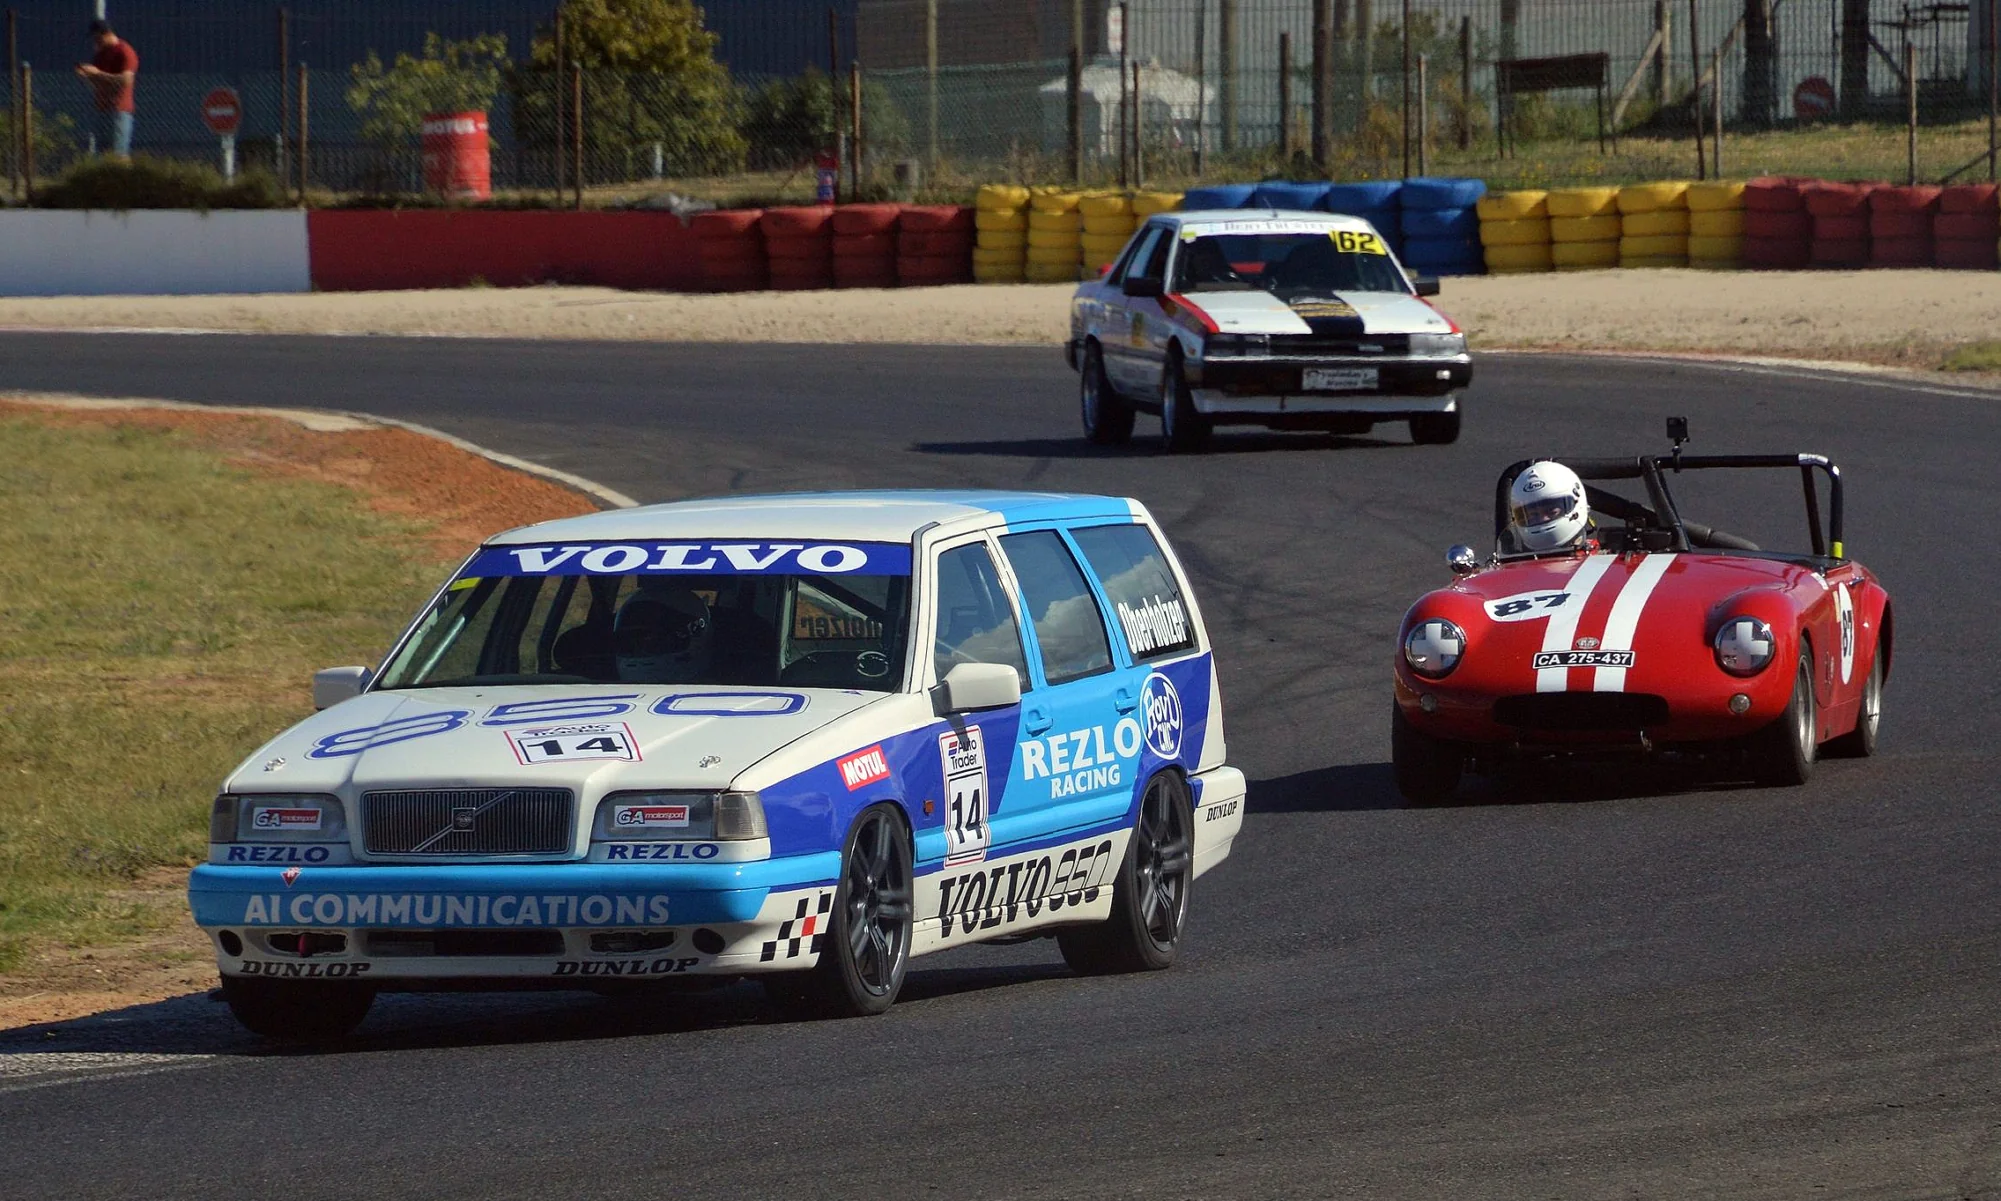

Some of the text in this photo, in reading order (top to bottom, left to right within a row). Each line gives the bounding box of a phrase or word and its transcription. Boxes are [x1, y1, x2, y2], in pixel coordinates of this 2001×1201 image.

[1339, 231, 1375, 251] 62
[509, 544, 868, 573] VOLVO
[1494, 592, 1571, 617] 87
[1118, 594, 1187, 654] Oberholzer
[1841, 609, 1852, 658] 87
[1538, 652, 1630, 666] CA 275-437
[303, 690, 813, 761] 850
[527, 737, 624, 755] 14
[957, 739, 977, 753] Auto
[1018, 717, 1141, 781] REZLO
[842, 750, 887, 787] MOTUL
[950, 753, 977, 770] Trader
[1051, 763, 1120, 799] RACING
[255, 812, 281, 827] GA
[617, 810, 685, 825] GA motorsport
[952, 788, 982, 844] 14
[1206, 801, 1238, 822] DUNLOP
[227, 846, 330, 862] REZLO
[607, 843, 719, 859] REZLO
[243, 894, 670, 924] AI COMMUNICATIONS
[240, 960, 371, 977] DUNLOP
[552, 957, 699, 976] DUNLOP
